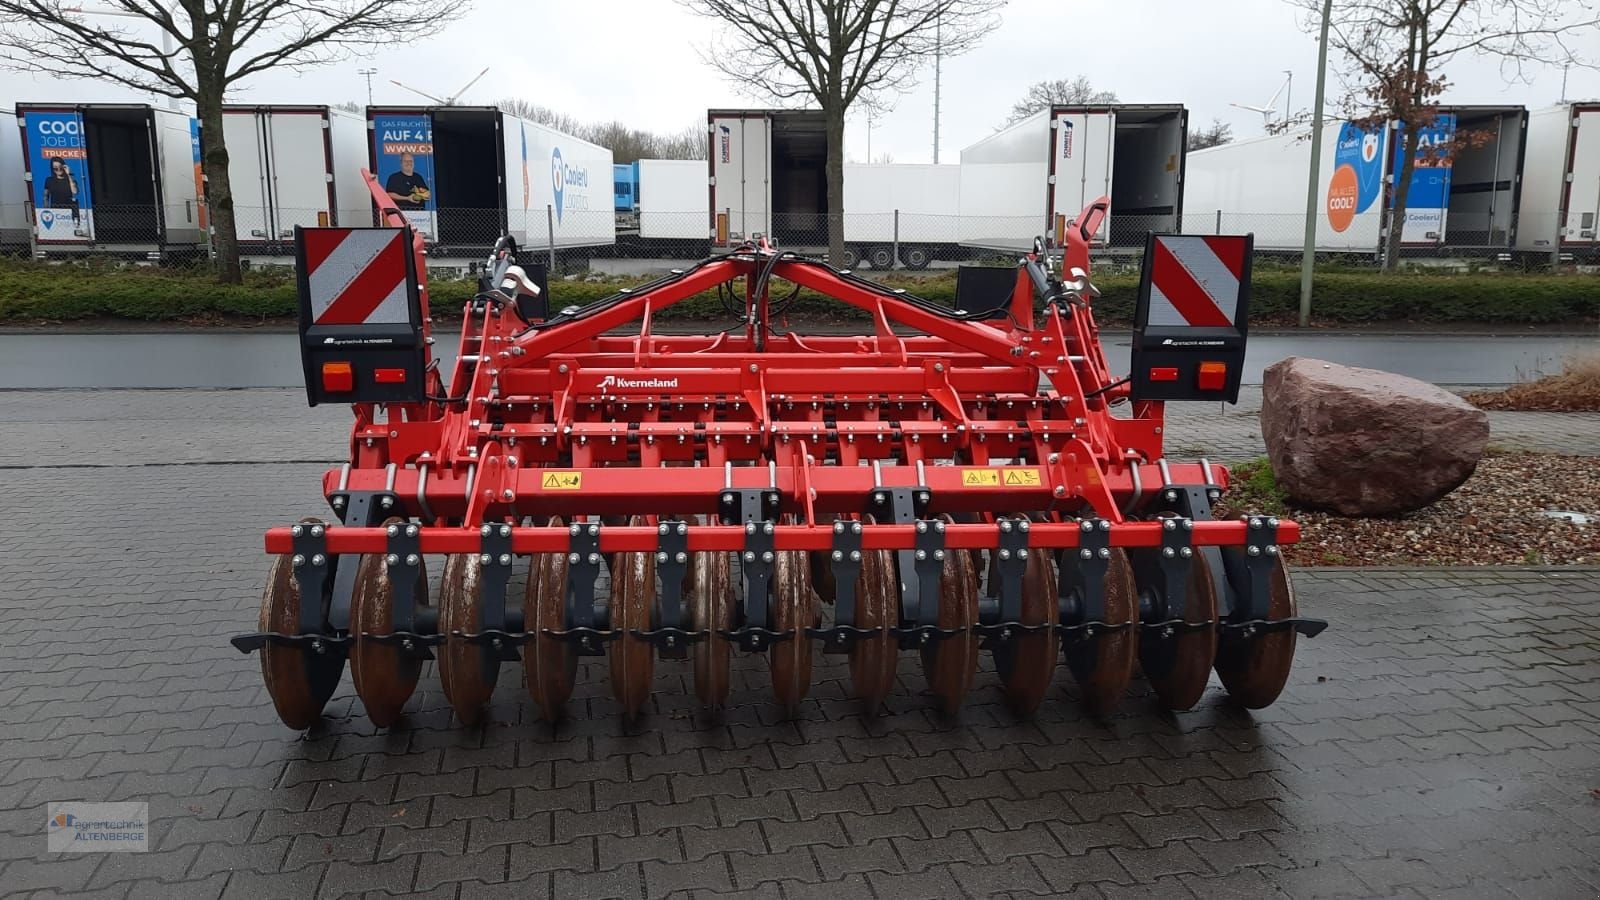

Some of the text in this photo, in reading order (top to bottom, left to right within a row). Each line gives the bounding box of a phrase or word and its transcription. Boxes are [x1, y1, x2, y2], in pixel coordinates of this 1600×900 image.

[384, 130, 411, 141] AUF
[415, 130, 424, 141] 4
[41, 136, 66, 147] JOB
[564, 163, 588, 187] CoolerU
[1329, 197, 1354, 209] COOL?
[617, 378, 678, 388] Kverneland
